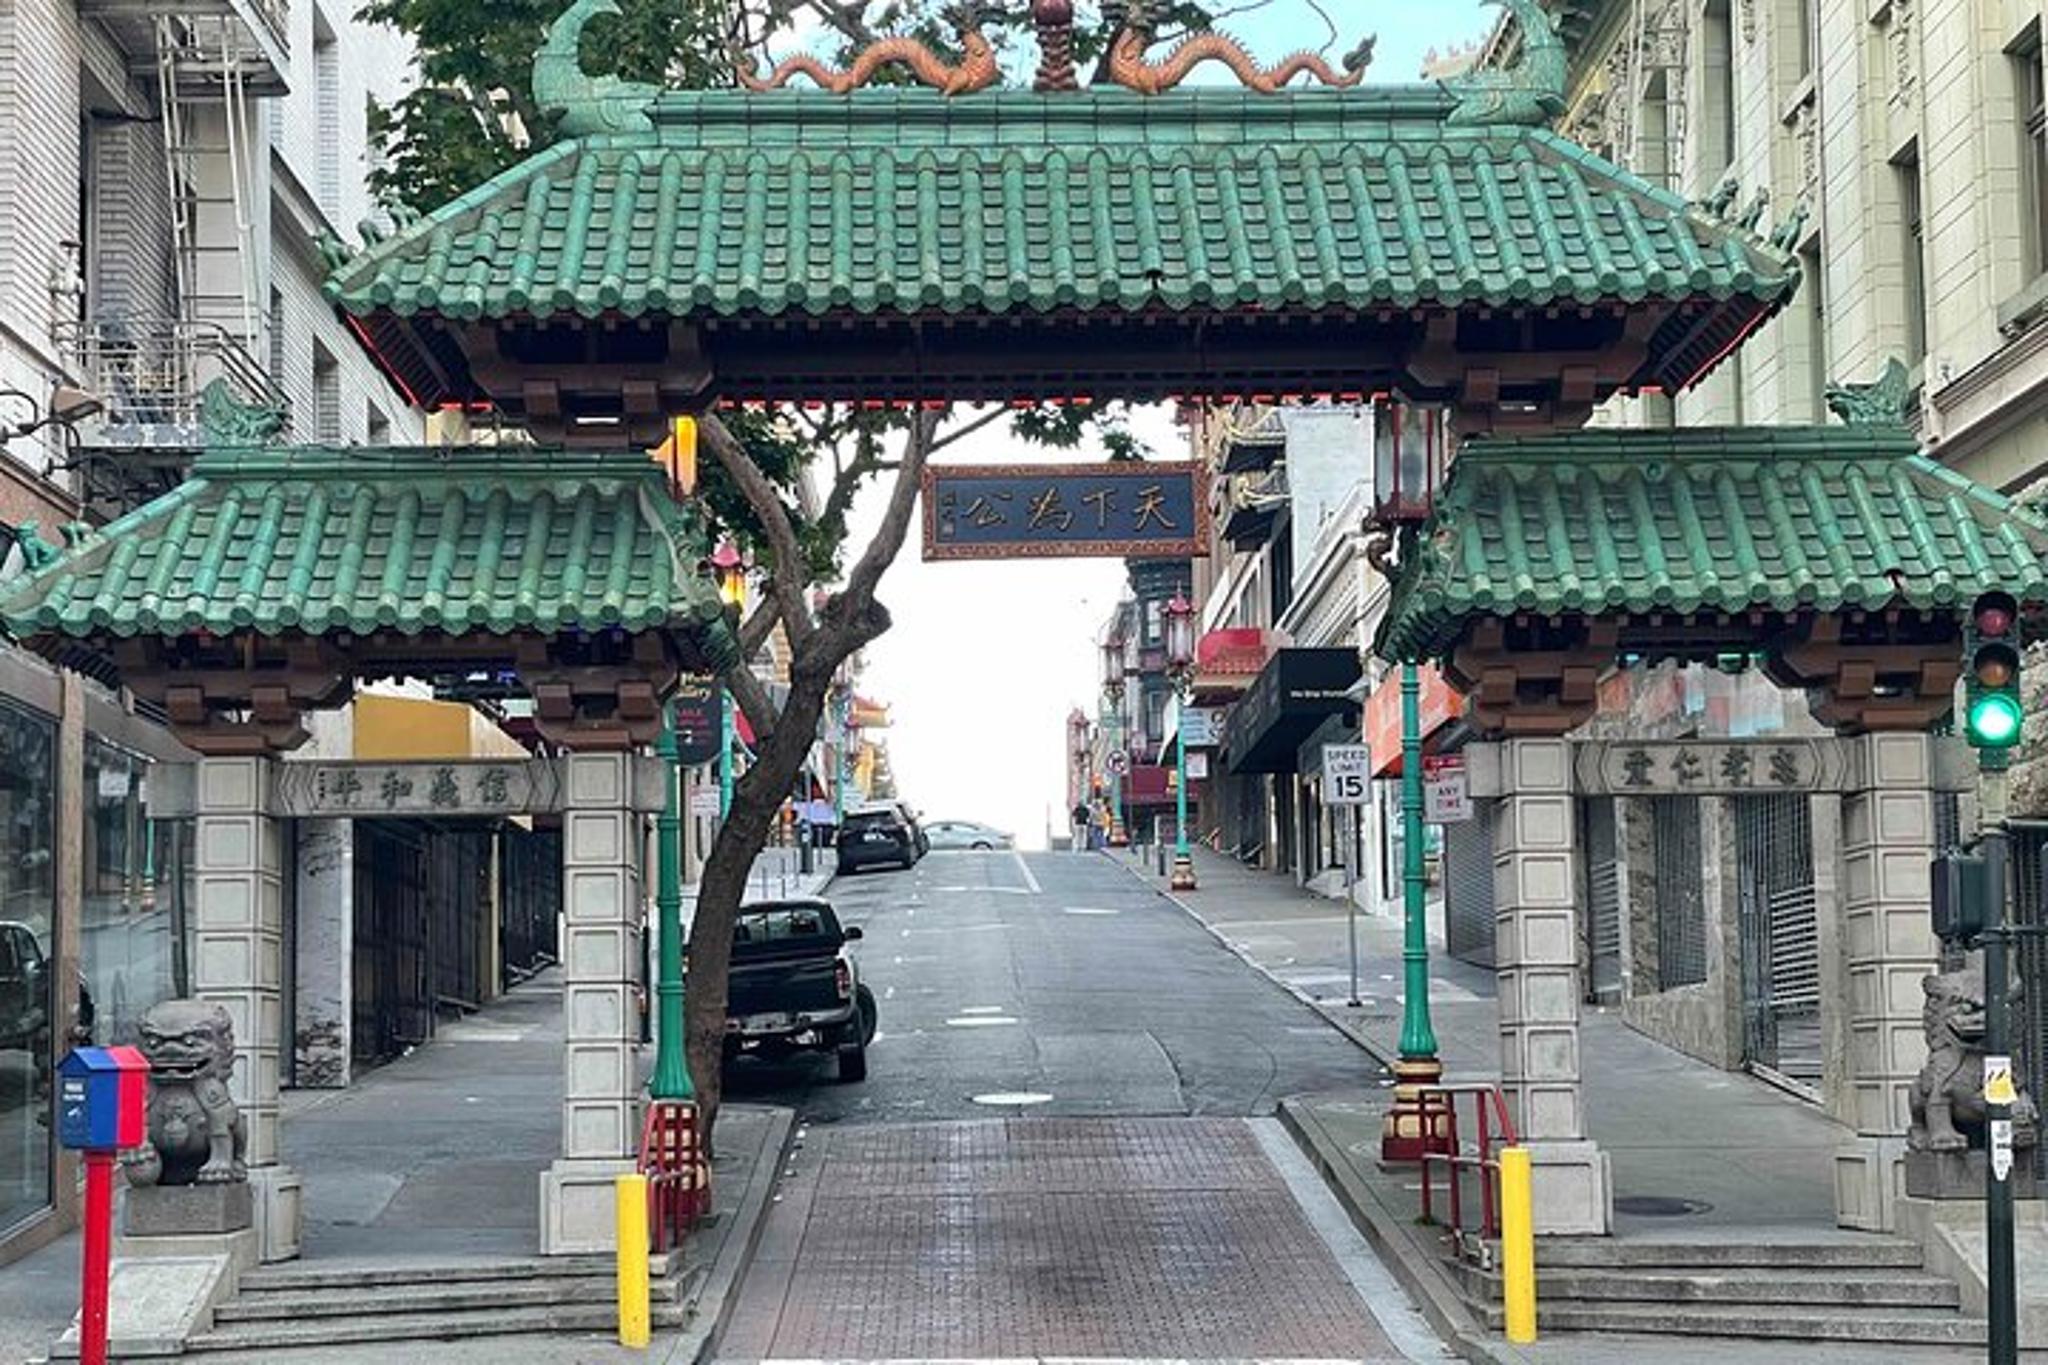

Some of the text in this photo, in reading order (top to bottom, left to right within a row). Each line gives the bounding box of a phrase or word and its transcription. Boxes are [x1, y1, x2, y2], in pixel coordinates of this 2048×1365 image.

[1327, 750, 1366, 760] SPEED
[1331, 763, 1362, 774] LIMIT
[1336, 775, 1364, 798] 15
[1439, 786, 1458, 796] ANY
